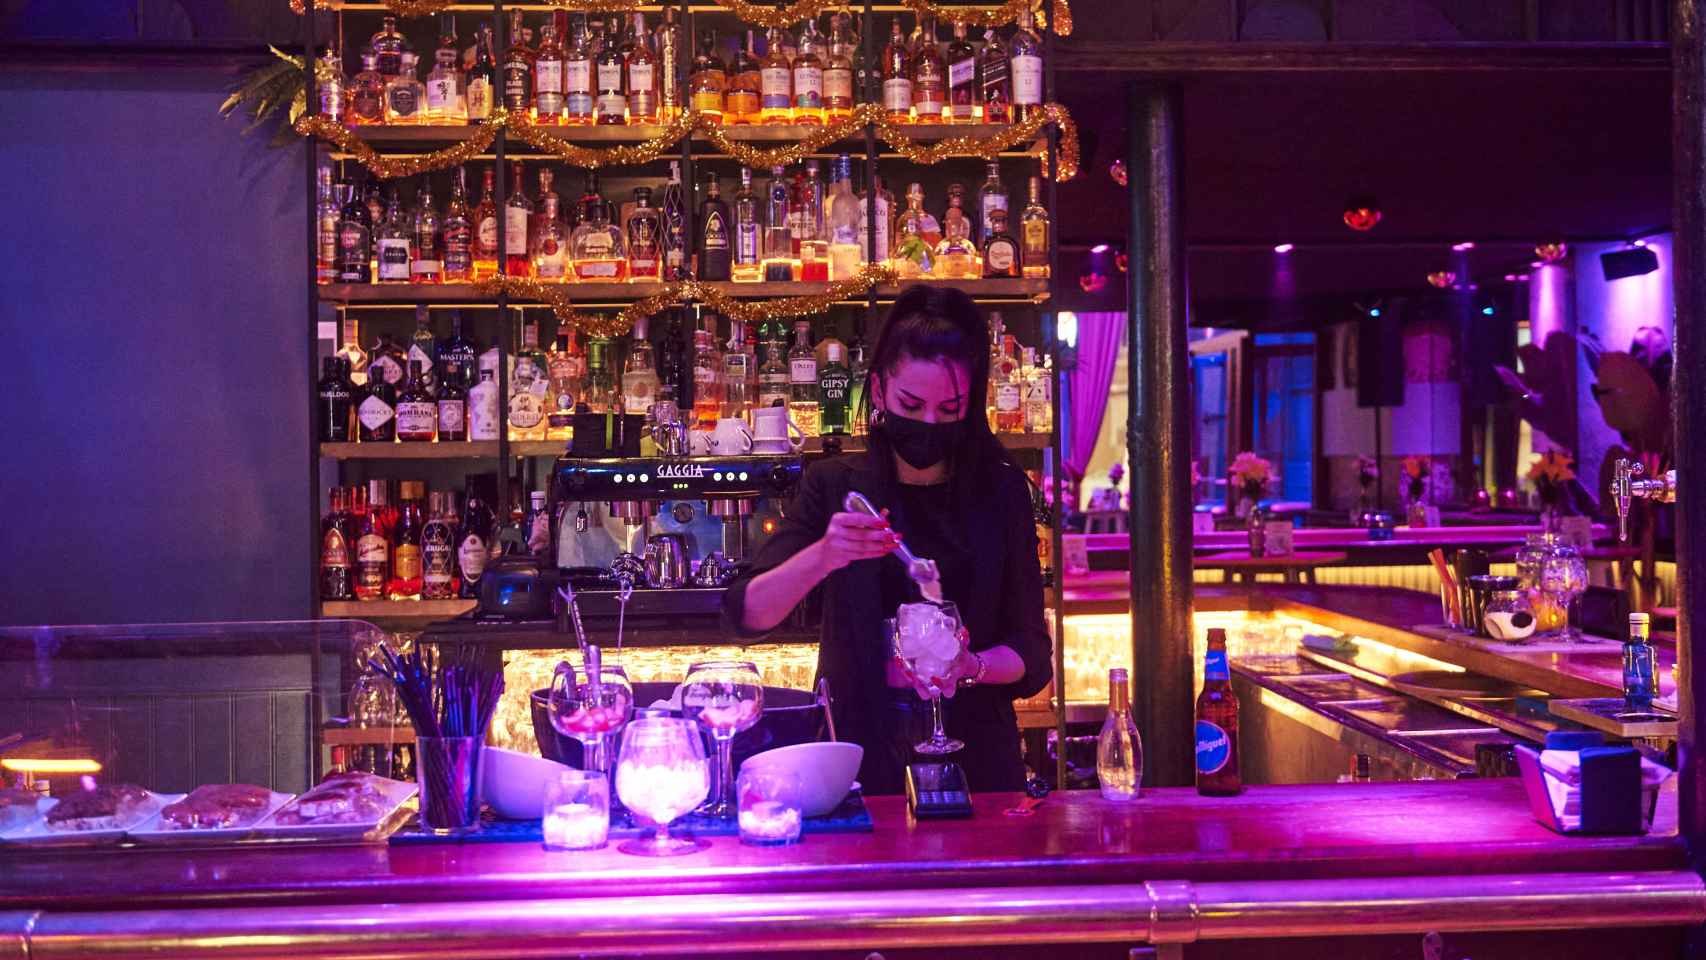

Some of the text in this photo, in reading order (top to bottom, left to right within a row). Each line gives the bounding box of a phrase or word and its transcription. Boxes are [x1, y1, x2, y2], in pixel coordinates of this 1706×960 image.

[822, 379, 849, 388] GIPSY
[827, 389, 843, 398] GIN
[657, 464, 704, 477] GAGGIA
